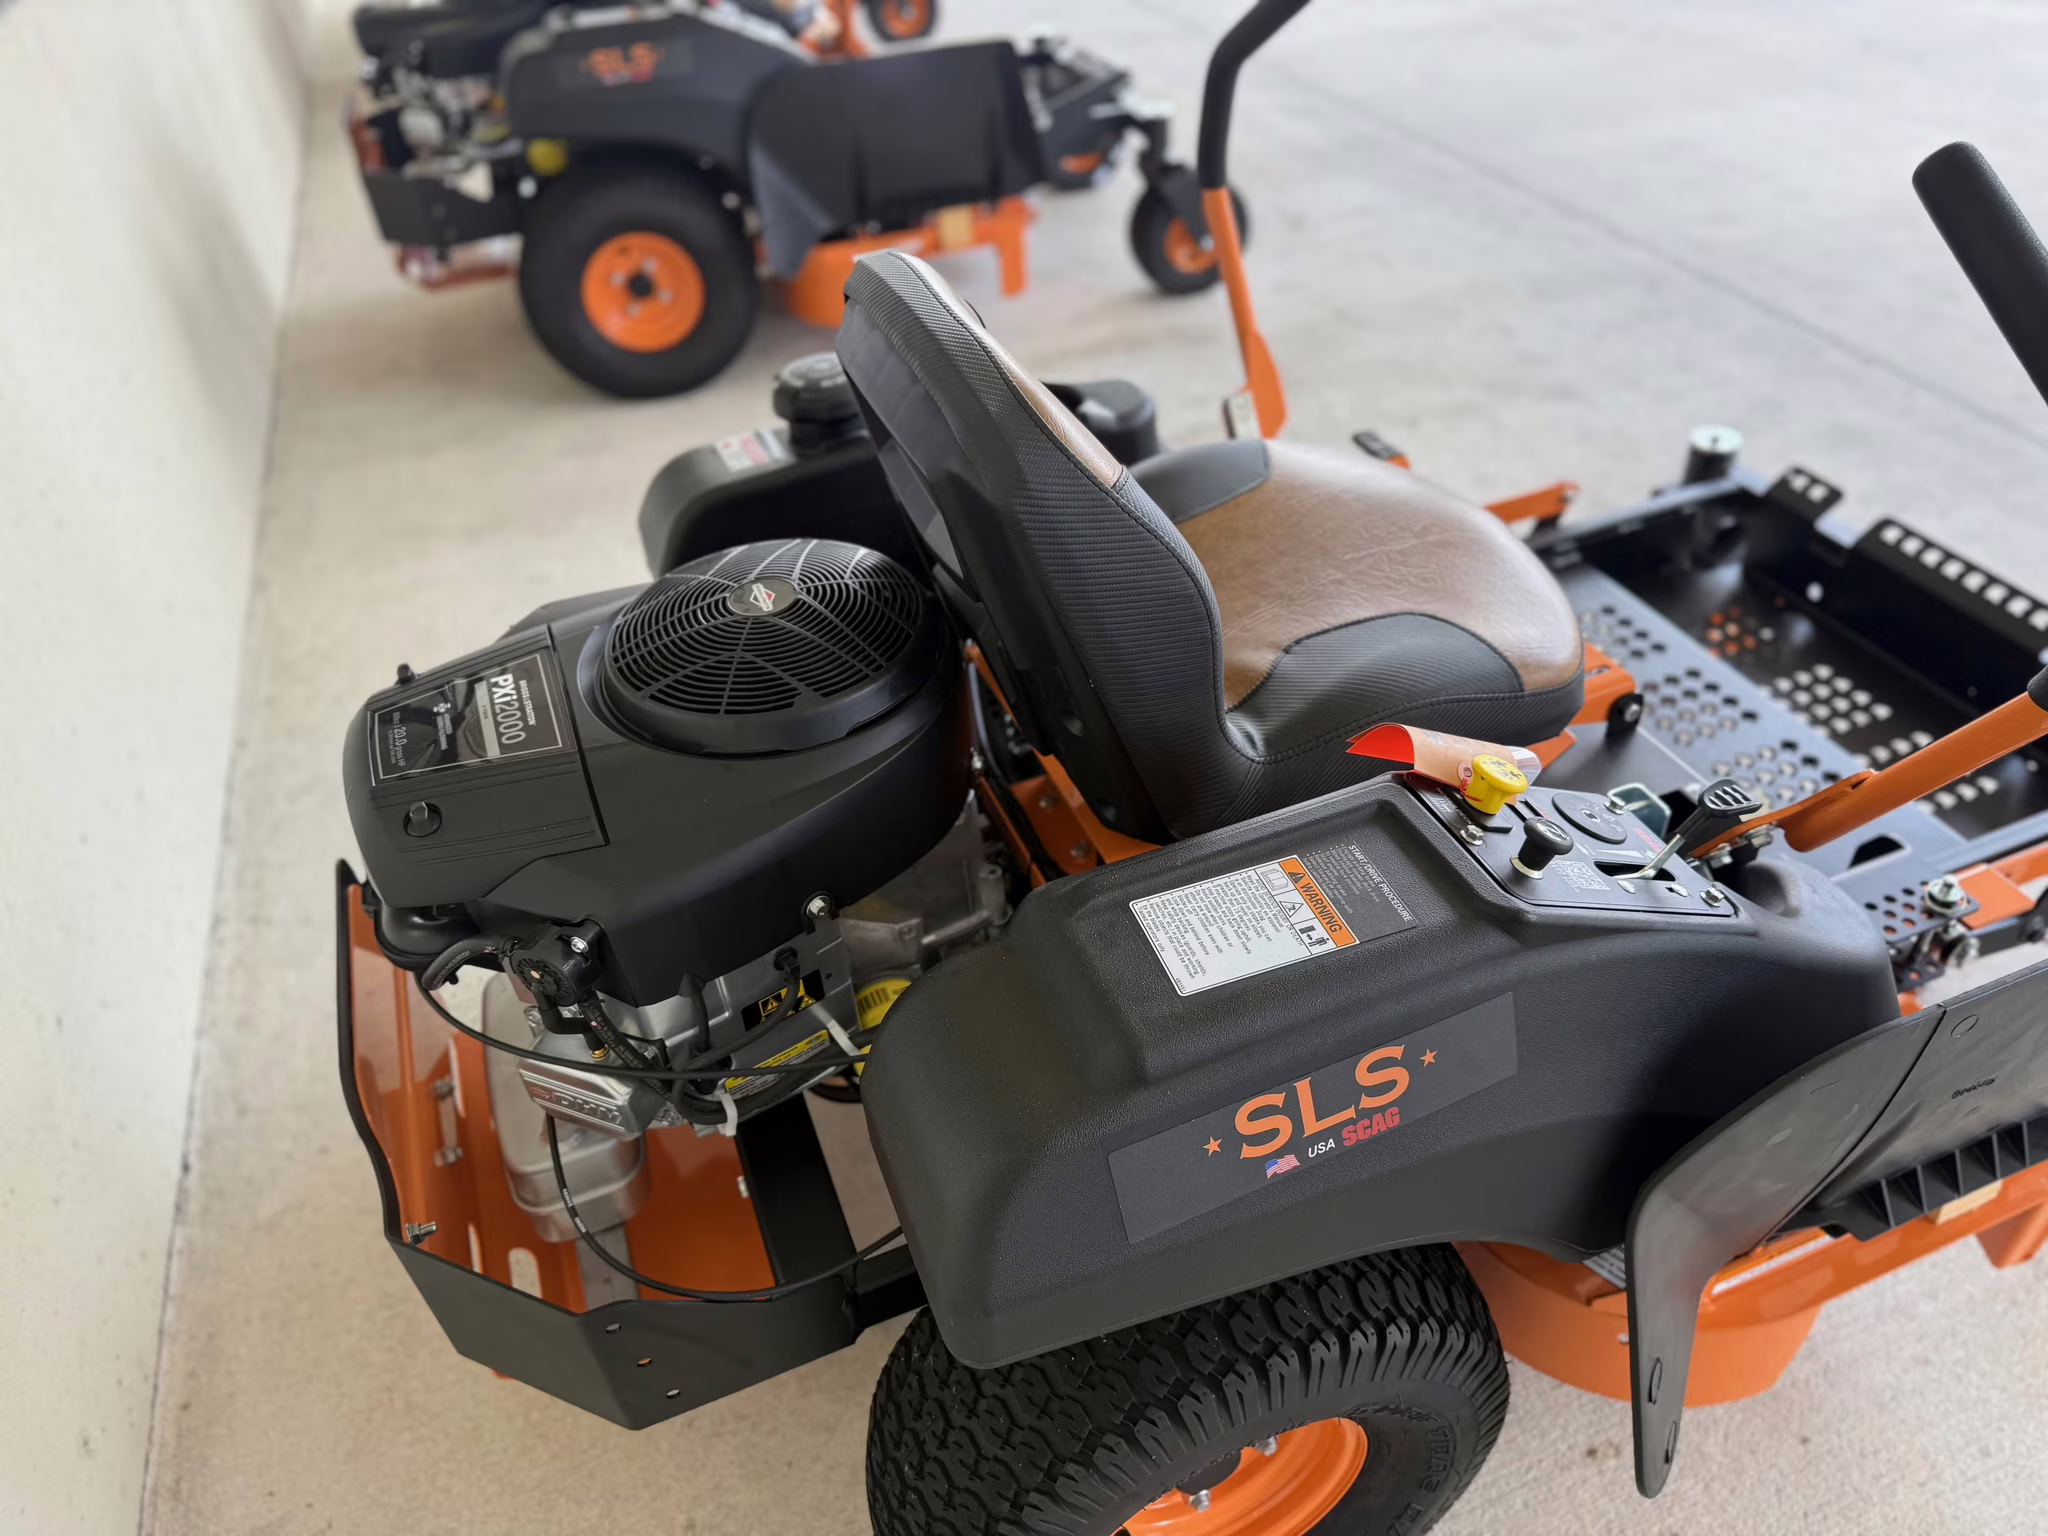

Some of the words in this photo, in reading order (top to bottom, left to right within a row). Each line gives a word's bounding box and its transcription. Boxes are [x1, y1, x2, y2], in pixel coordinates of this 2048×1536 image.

[1298, 882, 1344, 933] WARNING
[1346, 844, 1383, 883] START/DRIVE
[1376, 882, 1413, 922] PROCEDURE
[1170, 896, 1180, 906] Look
[1176, 906, 1187, 918] down
[1183, 918, 1192, 926] and
[1189, 926, 1202, 941] behind
[1197, 941, 1210, 955] before
[1289, 931, 1304, 946] DEATH
[1234, 1044, 1410, 1159] SLS
[1308, 1138, 1336, 1158] USA
[1341, 1107, 1401, 1148] SCAG
